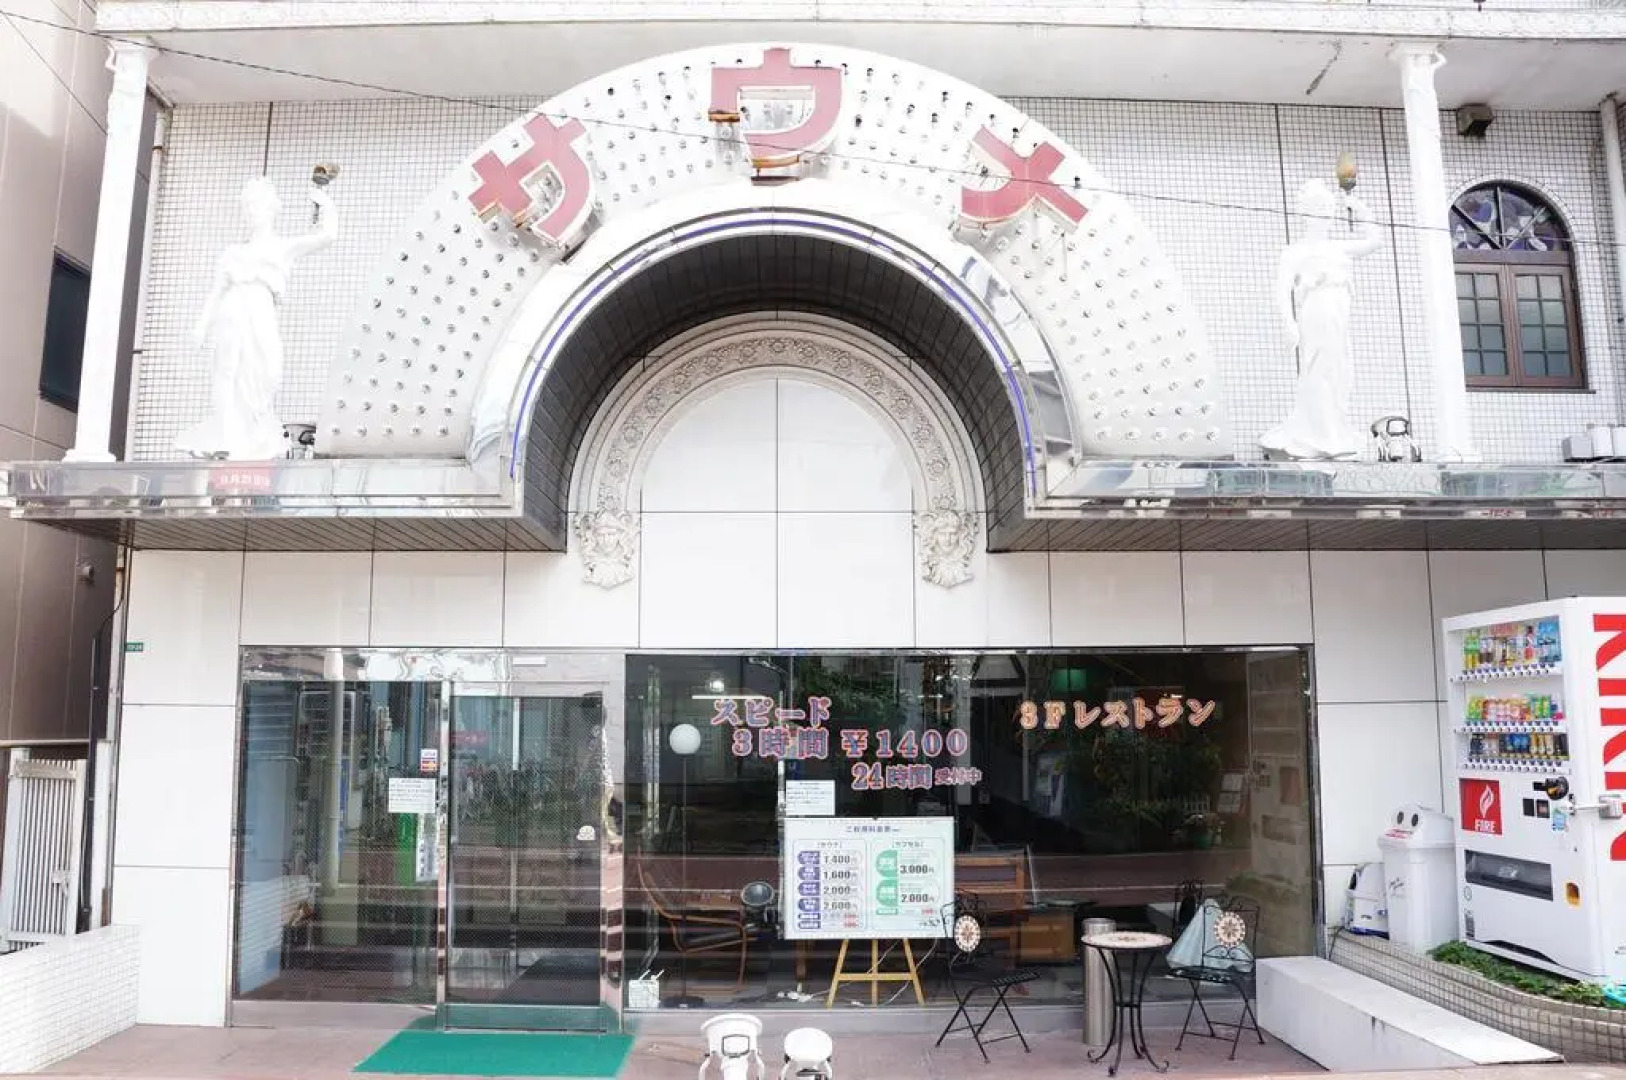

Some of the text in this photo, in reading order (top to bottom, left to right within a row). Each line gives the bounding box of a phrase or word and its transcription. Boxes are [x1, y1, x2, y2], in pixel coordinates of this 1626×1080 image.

[711, 697, 831, 726] スピード
[1020, 697, 1215, 729] 3Fレストラン
[732, 727, 829, 758] 3時間
[1474, 818, 1497, 834] FIRE
